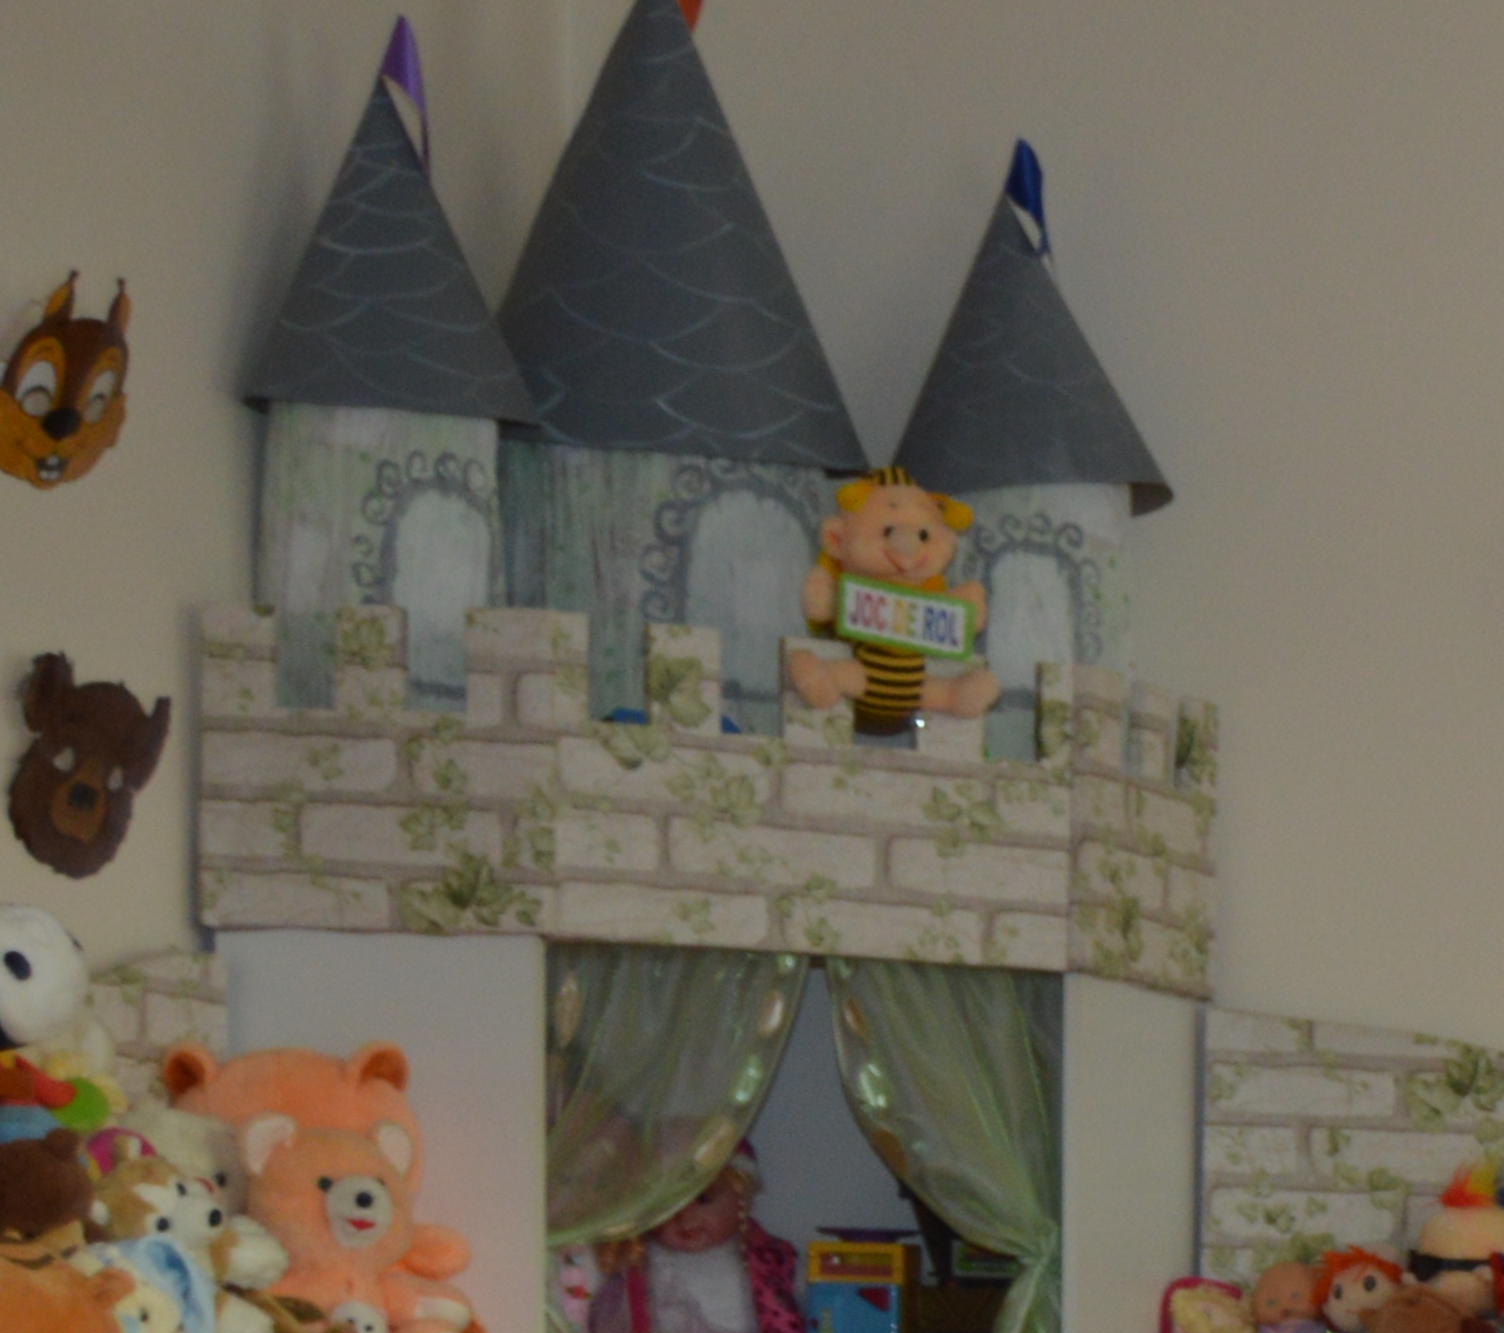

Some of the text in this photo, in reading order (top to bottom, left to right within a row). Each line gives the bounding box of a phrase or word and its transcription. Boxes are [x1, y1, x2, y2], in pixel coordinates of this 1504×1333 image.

[849, 590, 960, 647] JOC DE ROL
